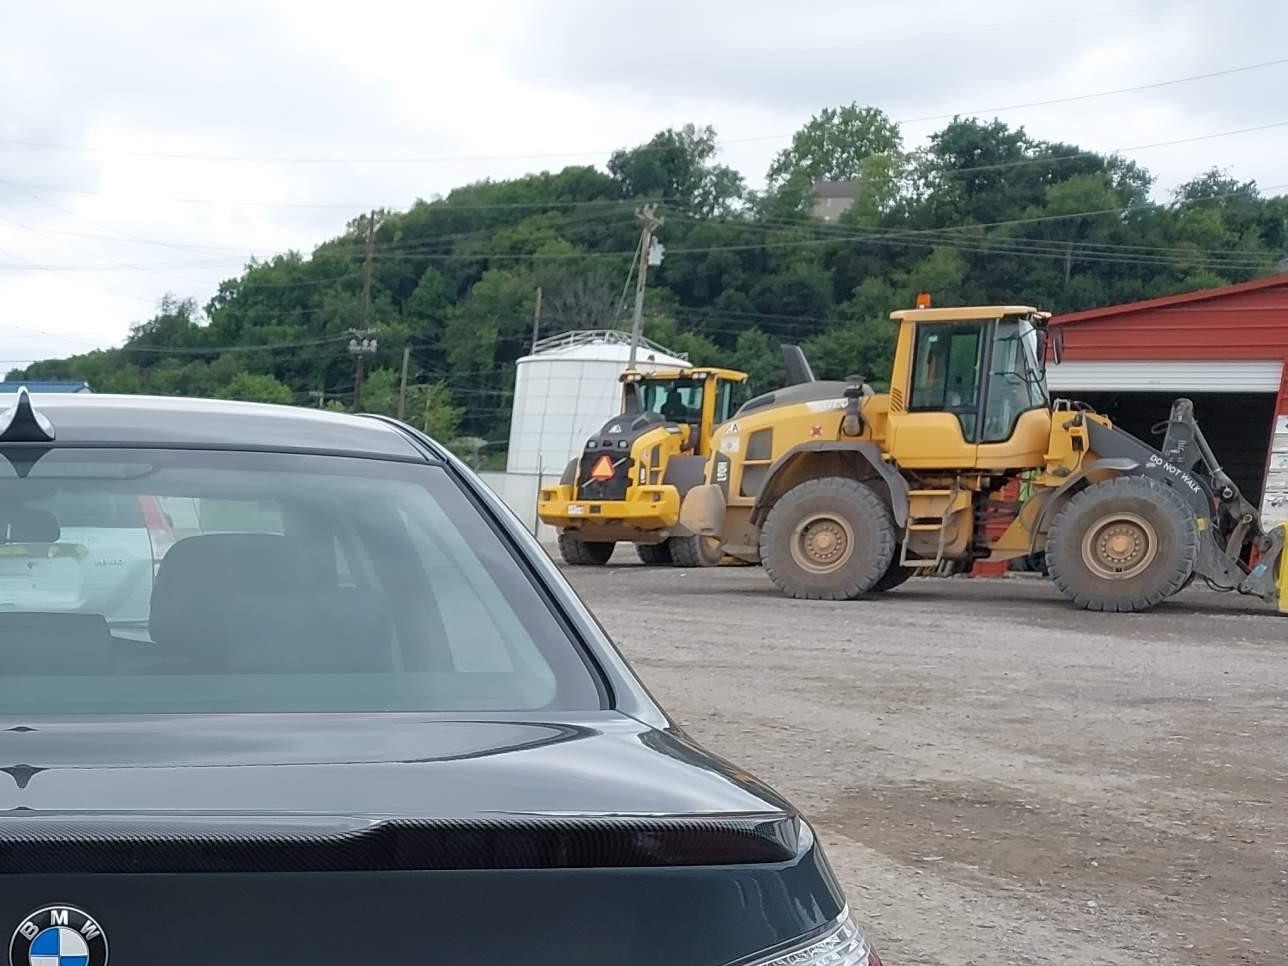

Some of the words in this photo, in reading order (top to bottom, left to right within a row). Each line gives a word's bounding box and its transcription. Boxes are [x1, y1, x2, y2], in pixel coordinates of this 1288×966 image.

[1150, 454, 1163, 465] DO
[1163, 462, 1182, 476] NOT
[1181, 473, 1201, 494] WALK
[19, 909, 100, 941] BMW
